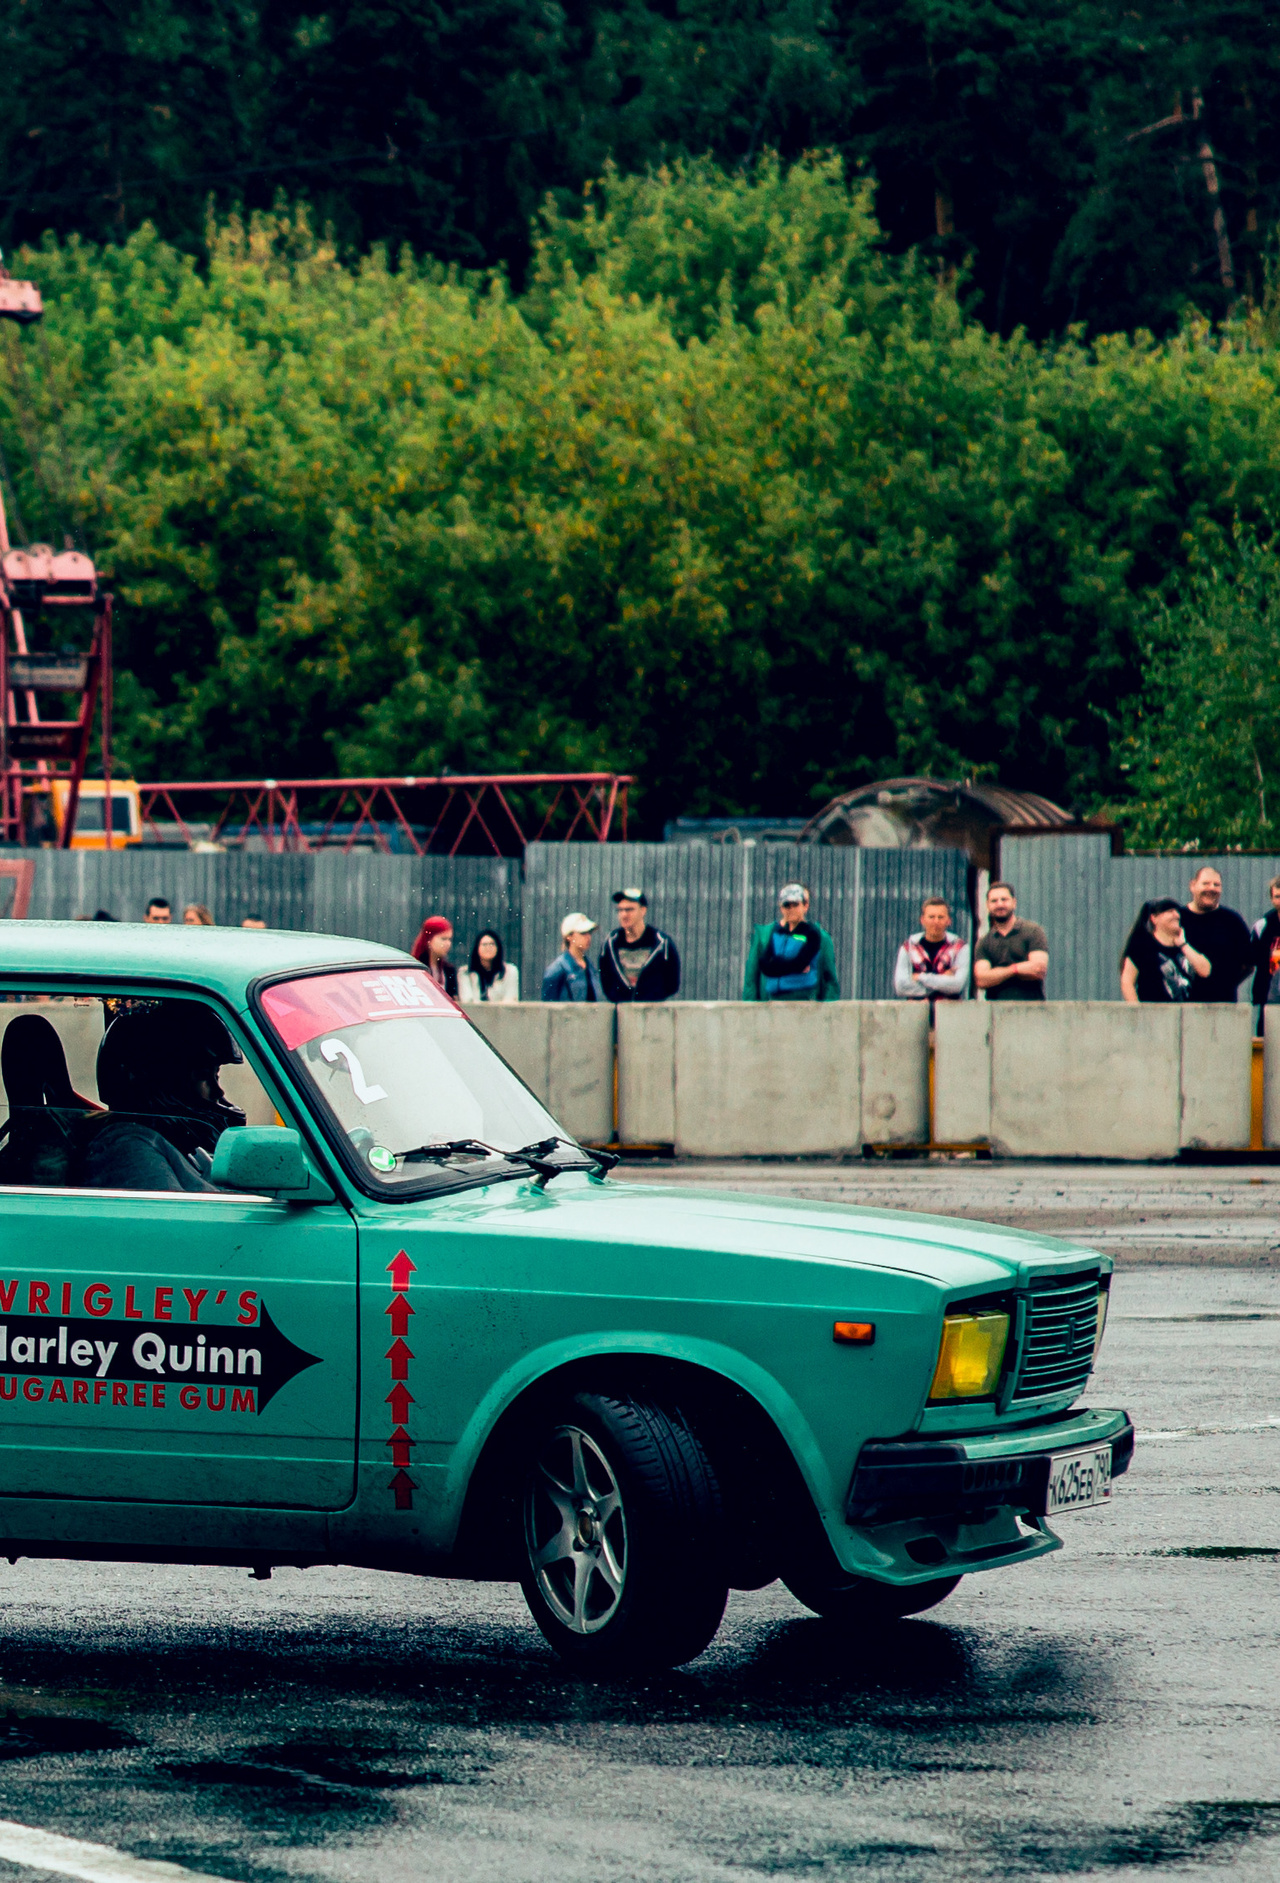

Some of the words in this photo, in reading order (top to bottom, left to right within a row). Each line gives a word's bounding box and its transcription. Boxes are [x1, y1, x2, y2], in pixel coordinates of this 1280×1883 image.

[320, 1038, 389, 1105] 2
[132, 1332, 262, 1375] Quinn
[179, 1385, 256, 1413] GUM
